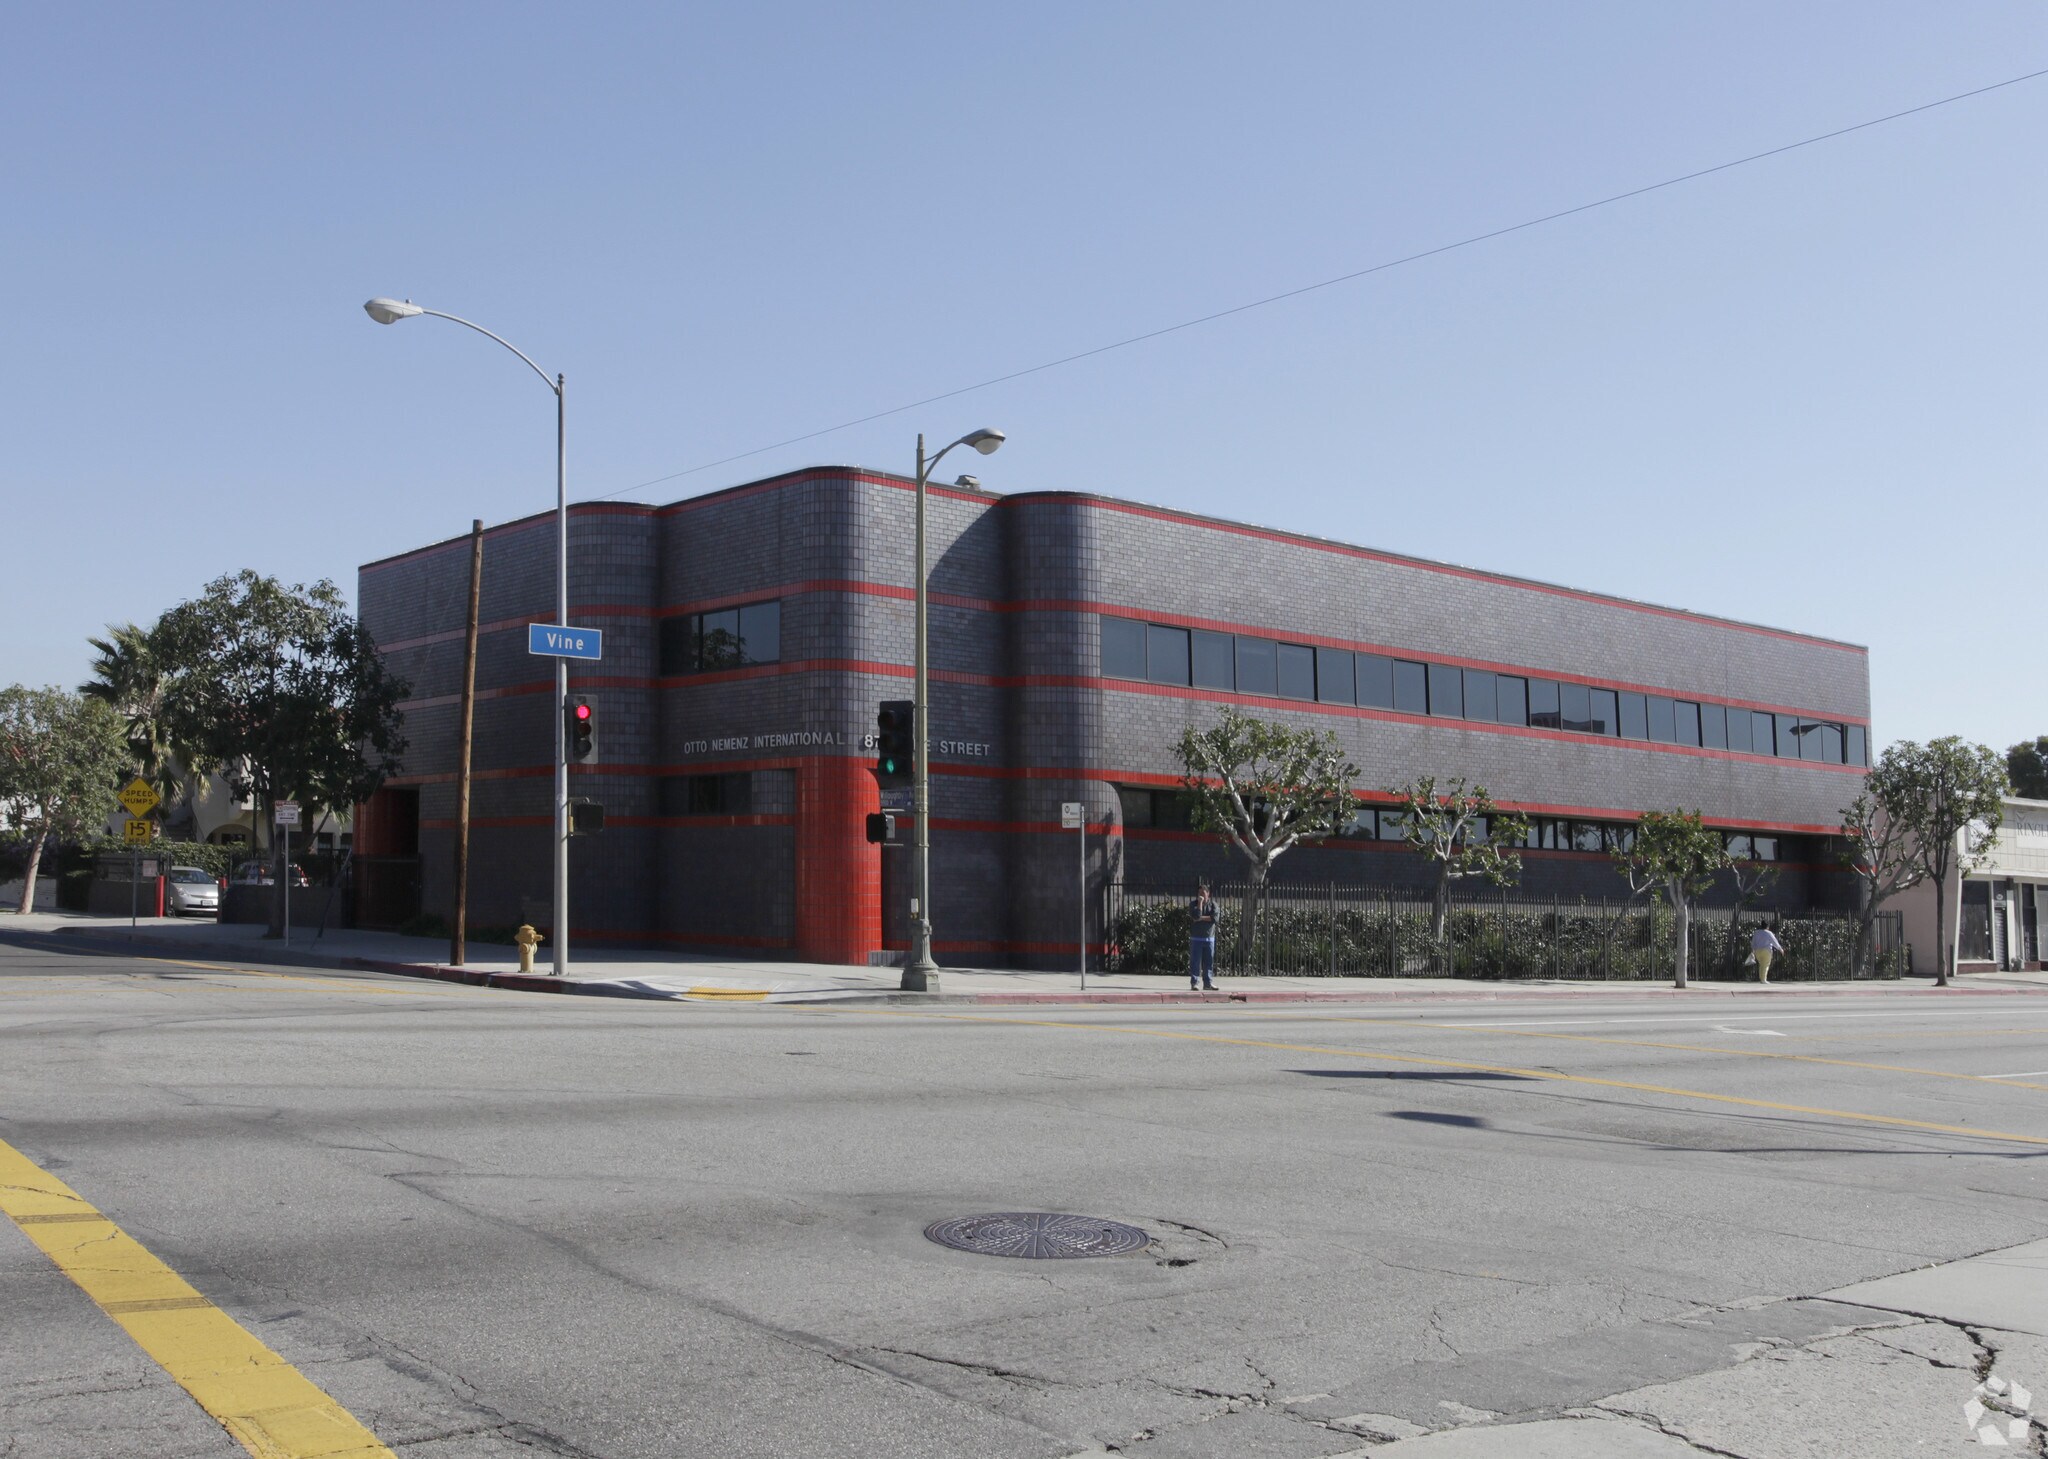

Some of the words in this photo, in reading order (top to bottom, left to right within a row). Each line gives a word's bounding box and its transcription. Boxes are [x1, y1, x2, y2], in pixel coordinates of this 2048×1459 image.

[547, 633, 584, 650] Vine
[684, 740, 708, 754] OTTO
[712, 737, 749, 751] NEMENZ
[754, 731, 846, 748] INTERNATIONAL
[940, 740, 990, 756] STREET
[126, 789, 153, 797] SPEED
[130, 822, 146, 836] 15
[2017, 822, 2048, 837] RINGL
